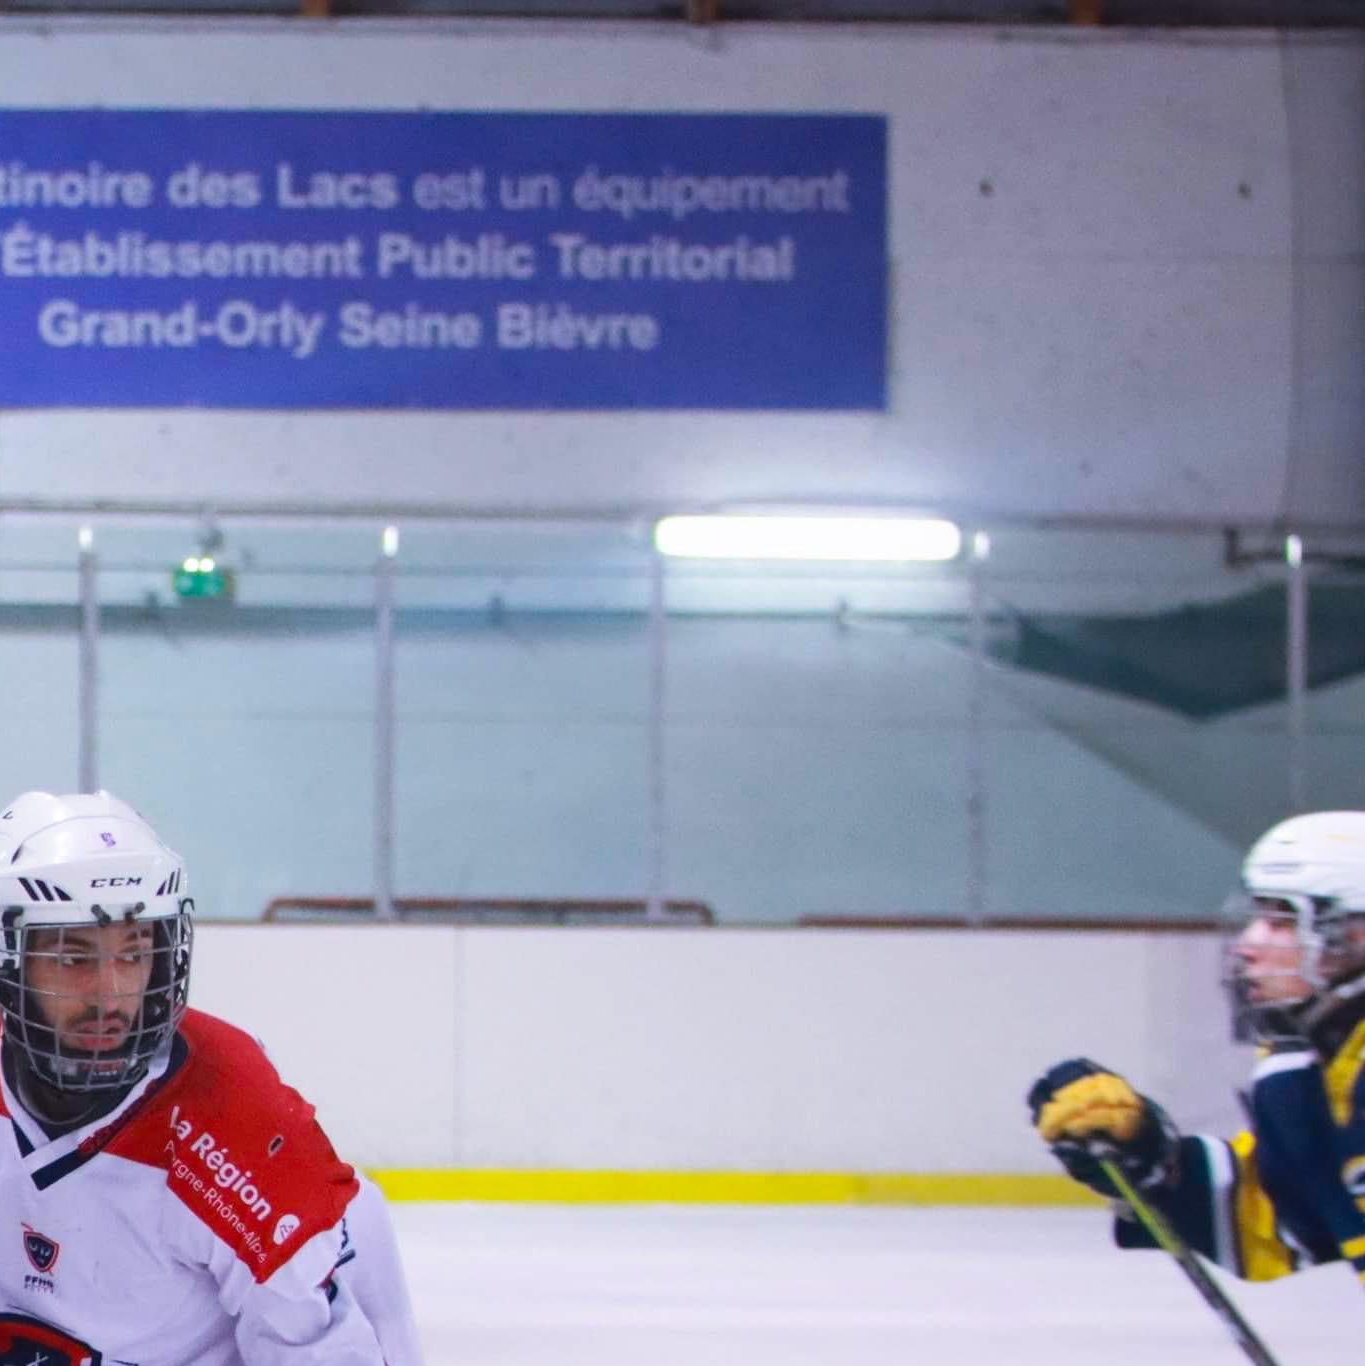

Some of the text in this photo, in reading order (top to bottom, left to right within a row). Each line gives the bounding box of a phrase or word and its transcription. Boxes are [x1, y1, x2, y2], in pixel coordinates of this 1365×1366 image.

[167, 163, 261, 209] des
[276, 163, 399, 210] Lacs
[412, 168, 486, 211] est
[499, 172, 560, 210] un
[573, 164, 850, 219] équipement
[377, 232, 536, 279] Public
[550, 232, 795, 281] Territorial
[38, 300, 659, 358] Grand-Orly Seine Bièvre
[90, 876, 143, 889] CCM
[169, 1104, 273, 1222] La Région
